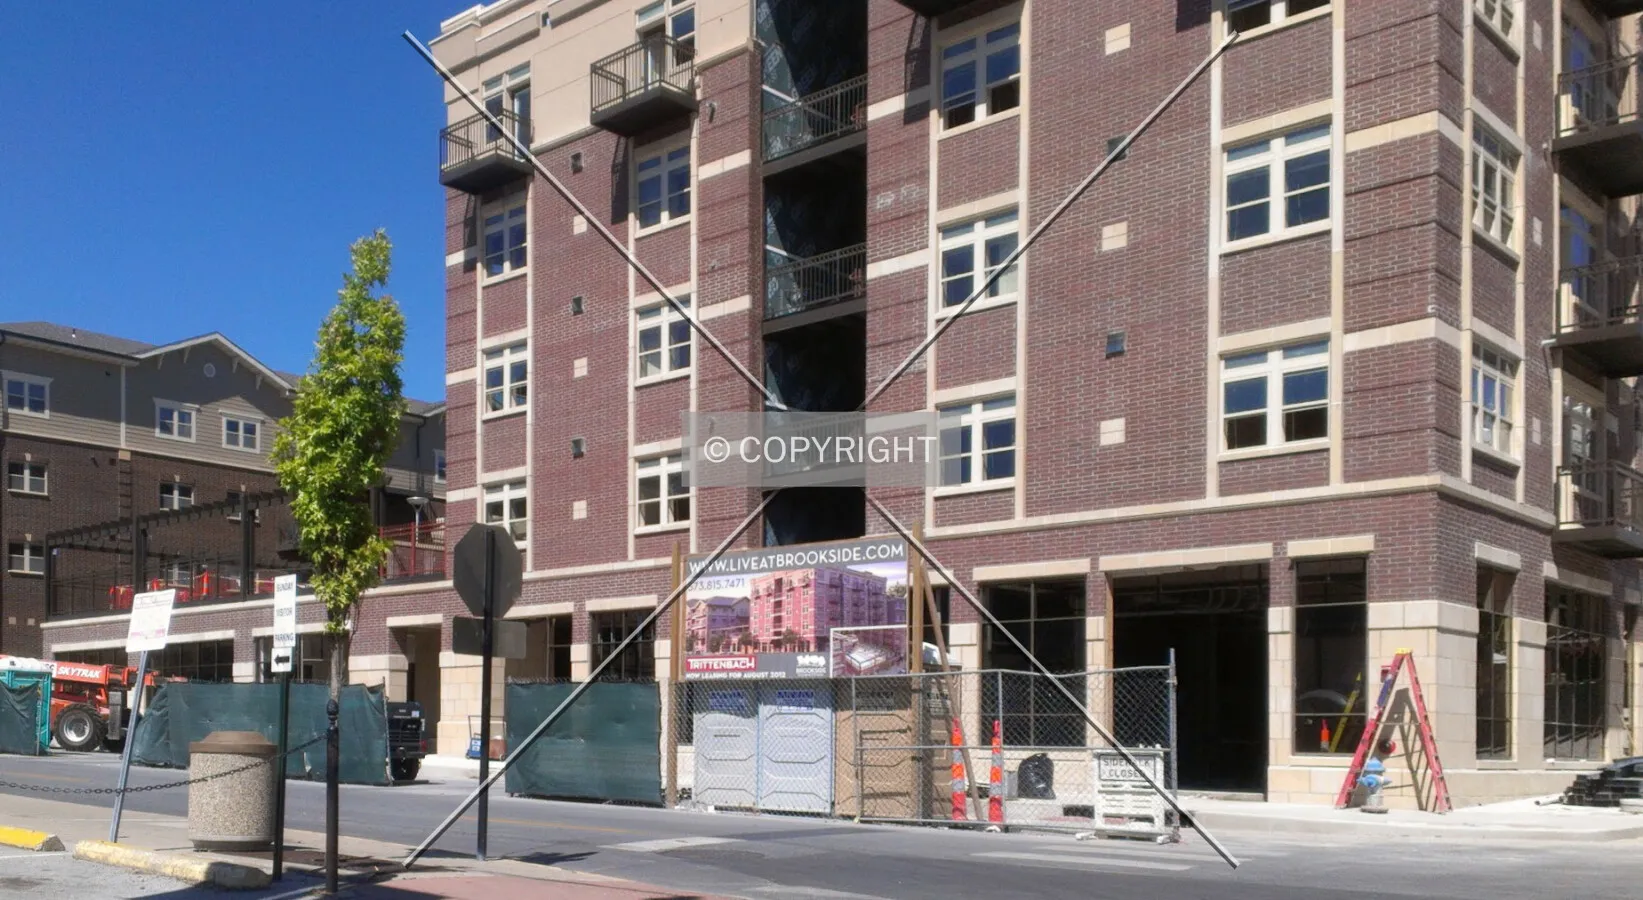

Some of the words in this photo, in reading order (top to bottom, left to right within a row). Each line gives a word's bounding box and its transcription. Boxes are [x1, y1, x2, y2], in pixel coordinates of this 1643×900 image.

[276, 582, 293, 592] SUNDAY
[275, 633, 294, 642] PARKING
[688, 657, 755, 669] TRITTENBACH
[57, 666, 102, 678] SKYTRAK
[1108, 769, 1146, 778] CLOSE
